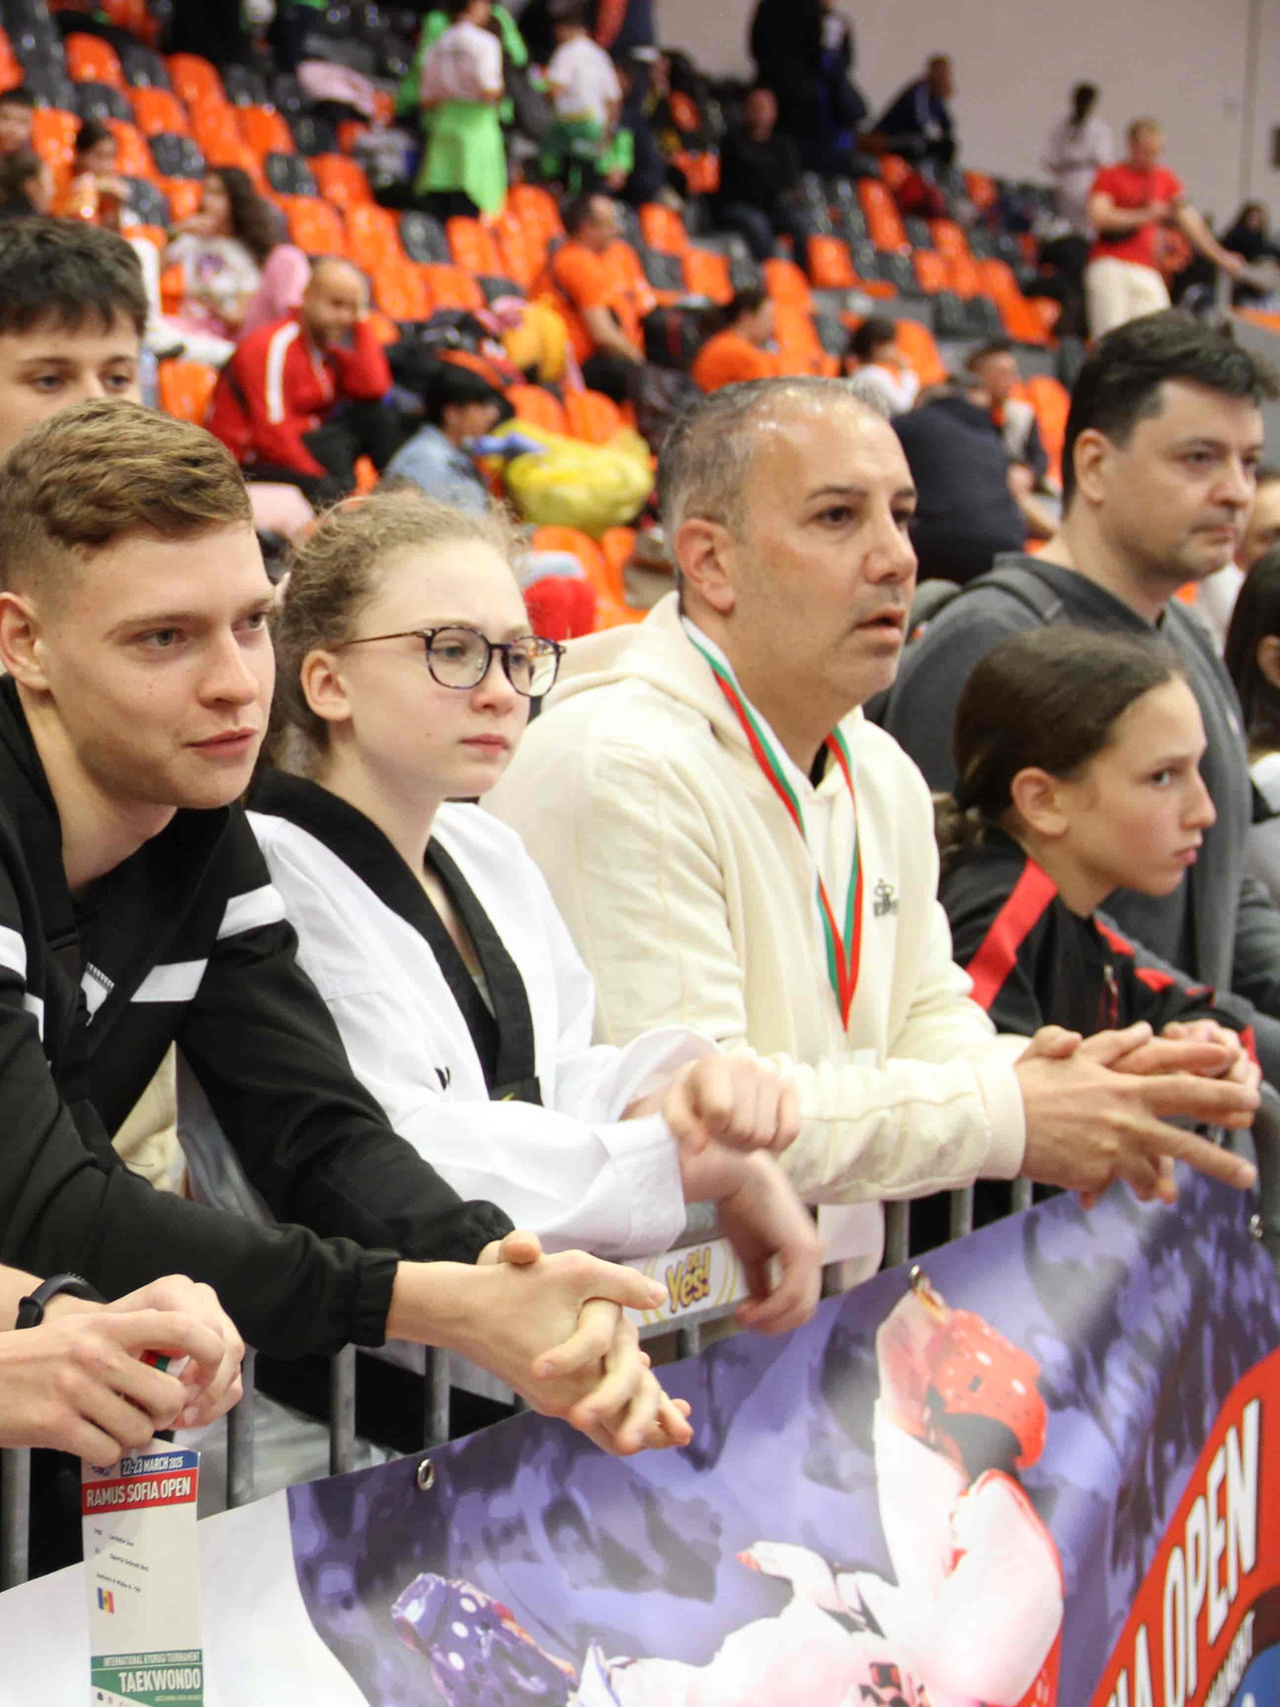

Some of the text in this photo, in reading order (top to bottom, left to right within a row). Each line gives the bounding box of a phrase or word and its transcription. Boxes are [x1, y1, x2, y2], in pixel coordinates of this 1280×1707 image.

[144, 1456, 169, 1472] MARCH
[86, 1476, 191, 1507] RAMUS SOFIA OPEN
[1163, 1397, 1261, 1707] OPEN
[118, 1668, 200, 1692] TAEKWONDO
